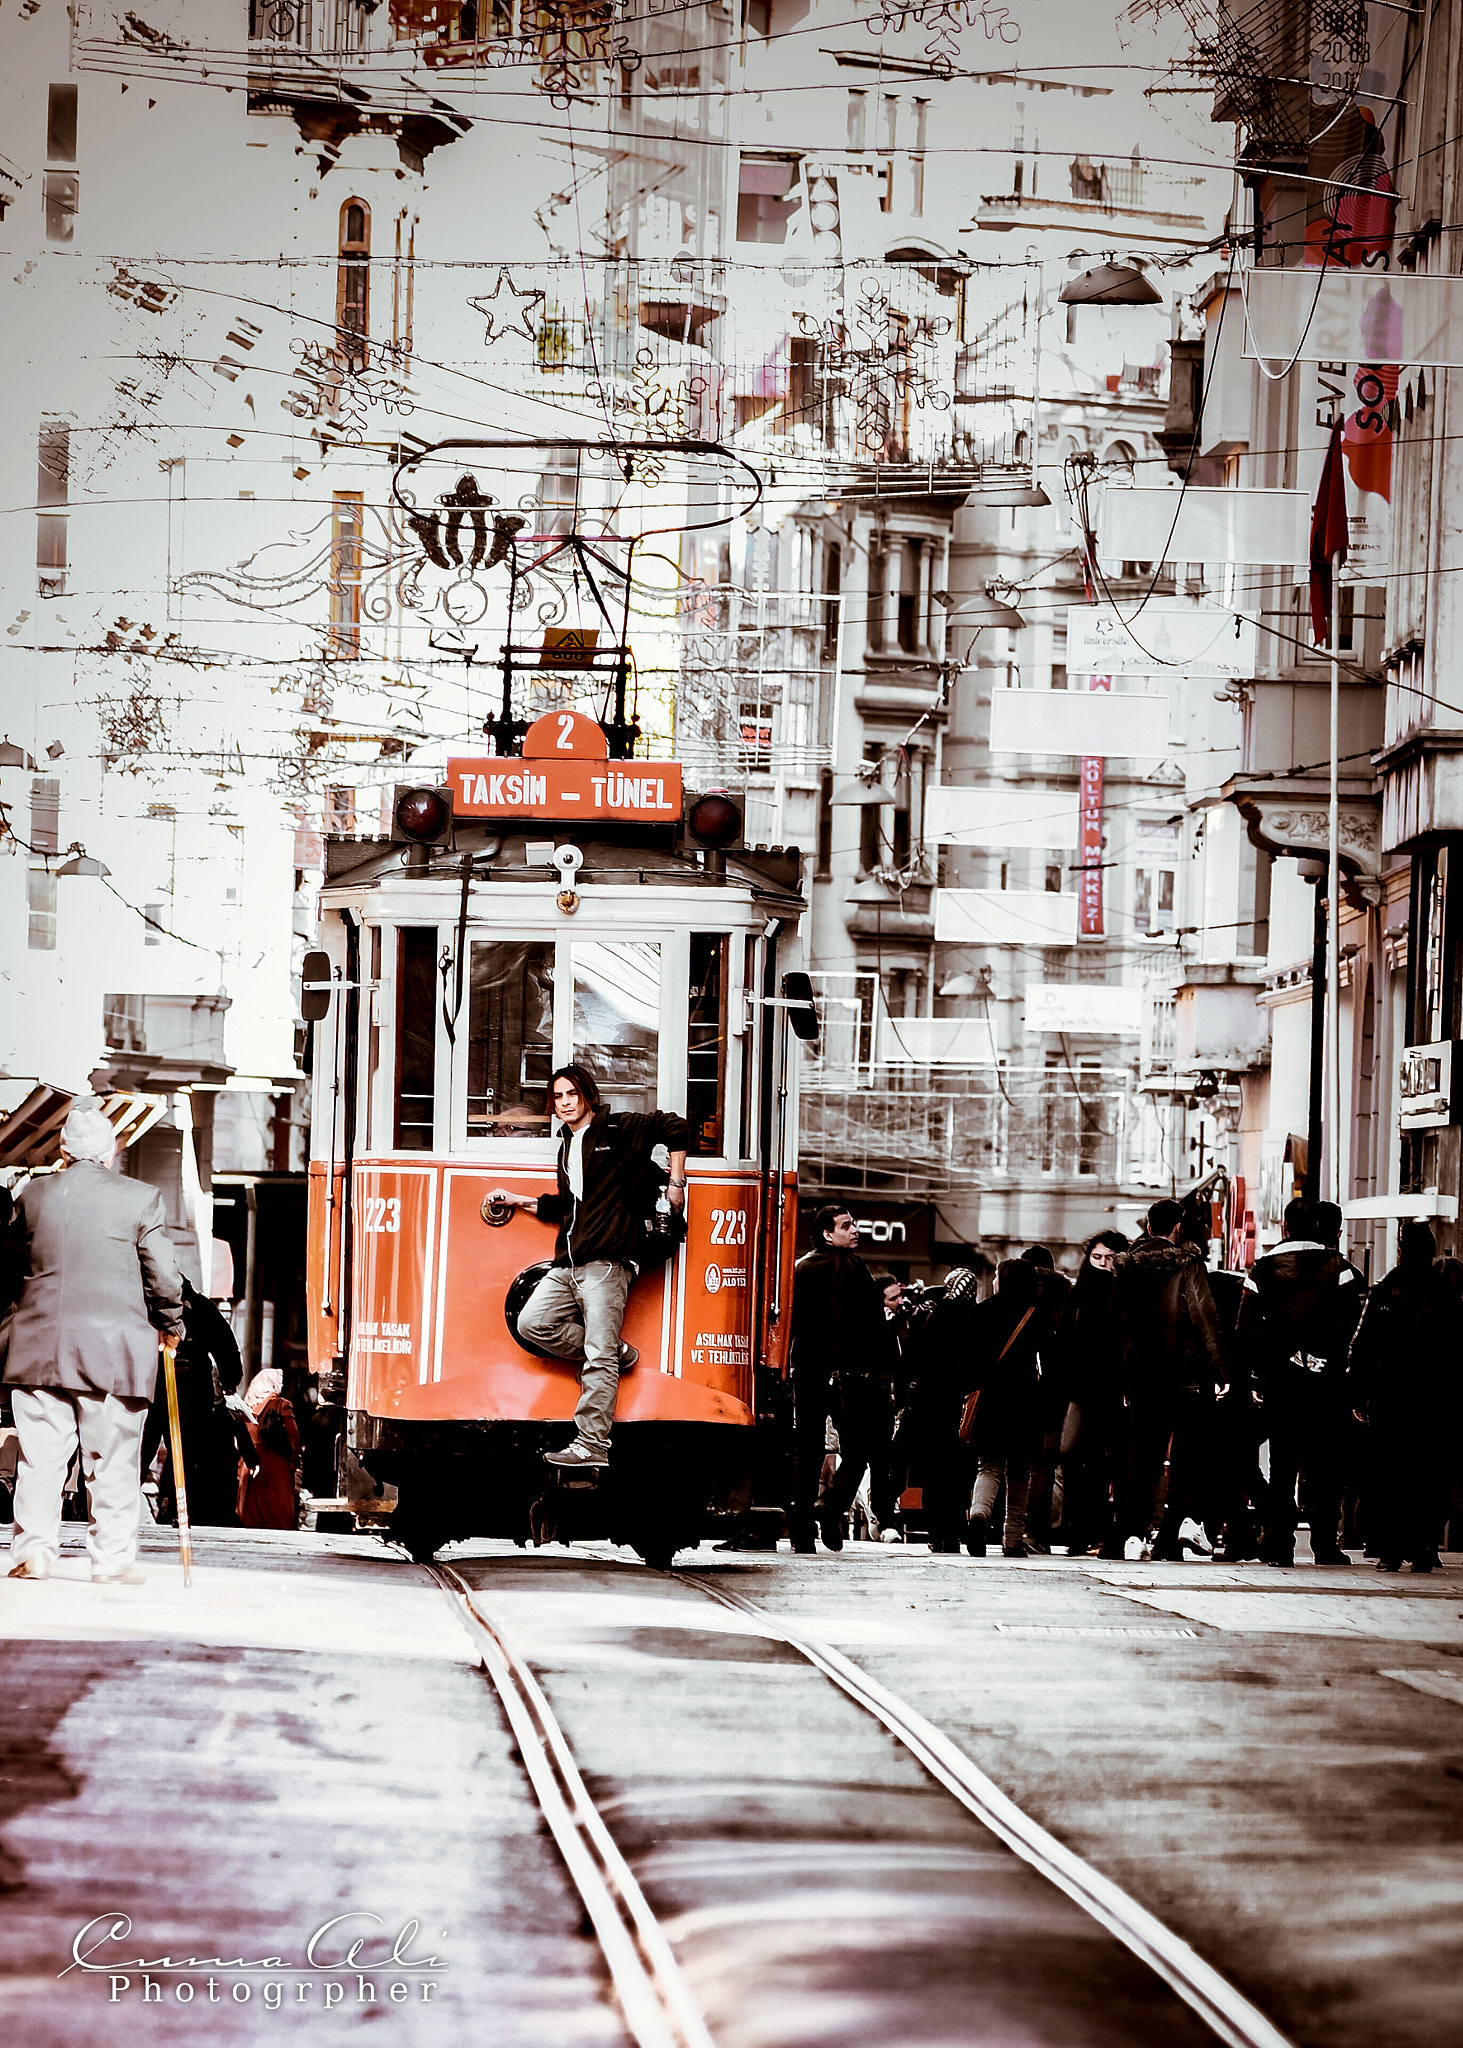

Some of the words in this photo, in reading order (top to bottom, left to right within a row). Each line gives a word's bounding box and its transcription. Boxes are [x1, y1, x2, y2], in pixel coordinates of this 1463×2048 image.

[556, 714, 574, 750] 2
[458, 768, 547, 806] TAKSİM
[590, 771, 673, 810] TÜNEL
[365, 1197, 401, 1233] 223
[710, 1208, 747, 1245] 223
[380, 1322, 411, 1337] YASAK
[690, 1349, 705, 1364] VE
